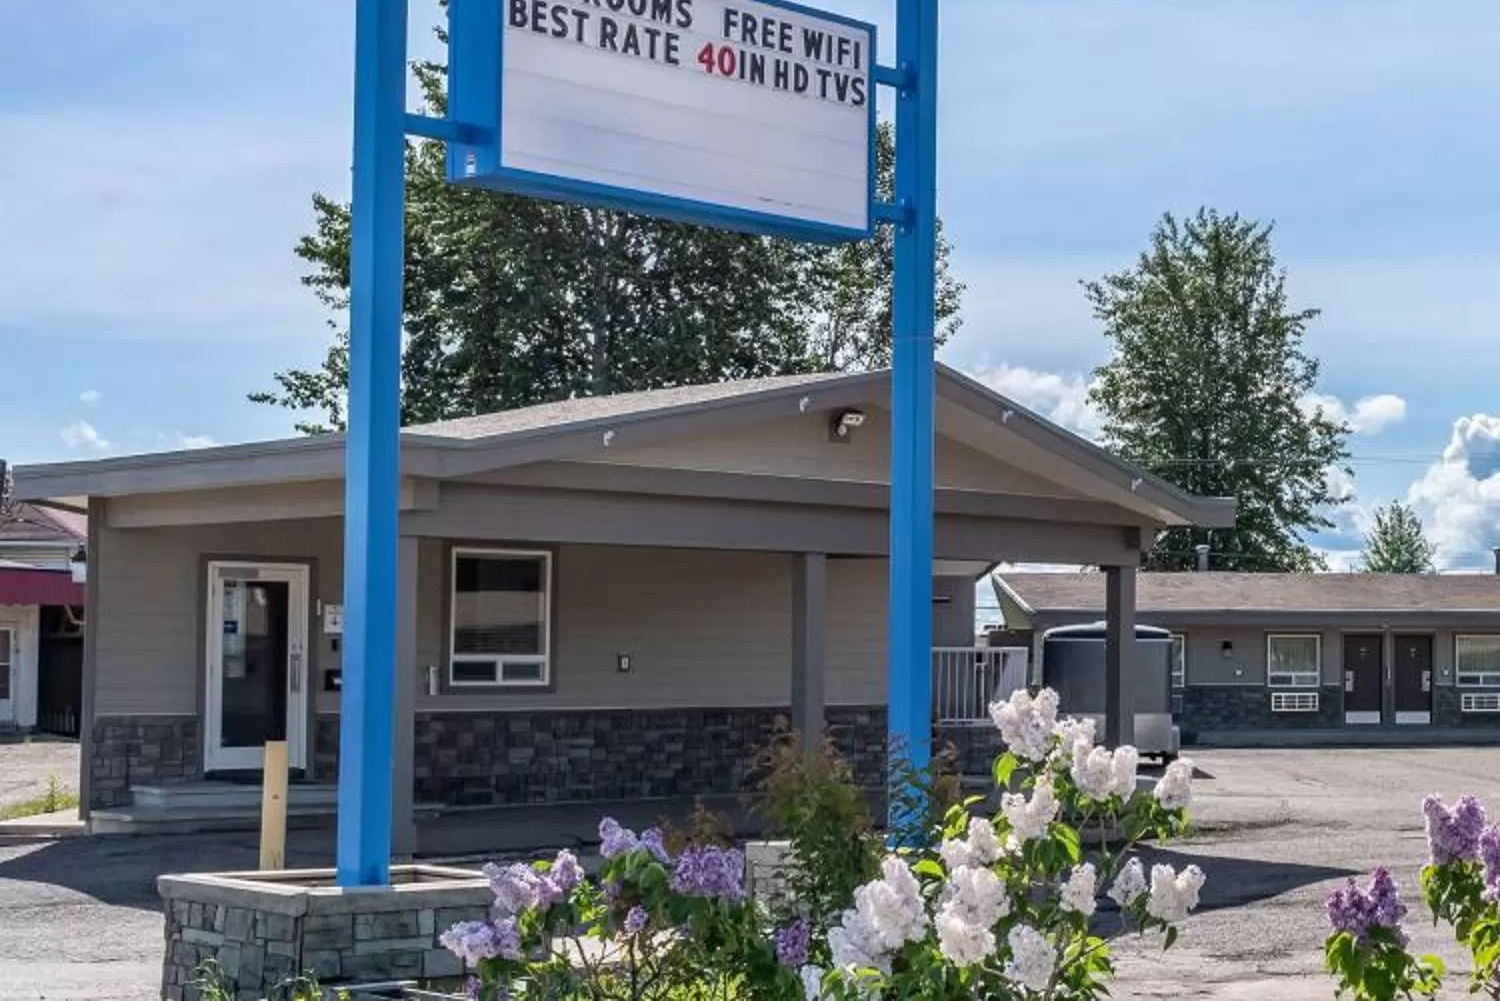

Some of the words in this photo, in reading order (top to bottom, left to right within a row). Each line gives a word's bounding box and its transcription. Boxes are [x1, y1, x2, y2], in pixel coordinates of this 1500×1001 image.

[600, 17, 680, 65] RATE
[774, 58, 809, 93] HD
[816, 68, 866, 106] TVS
[723, 7, 793, 53] FREE
[802, 28, 861, 70] WIFI
